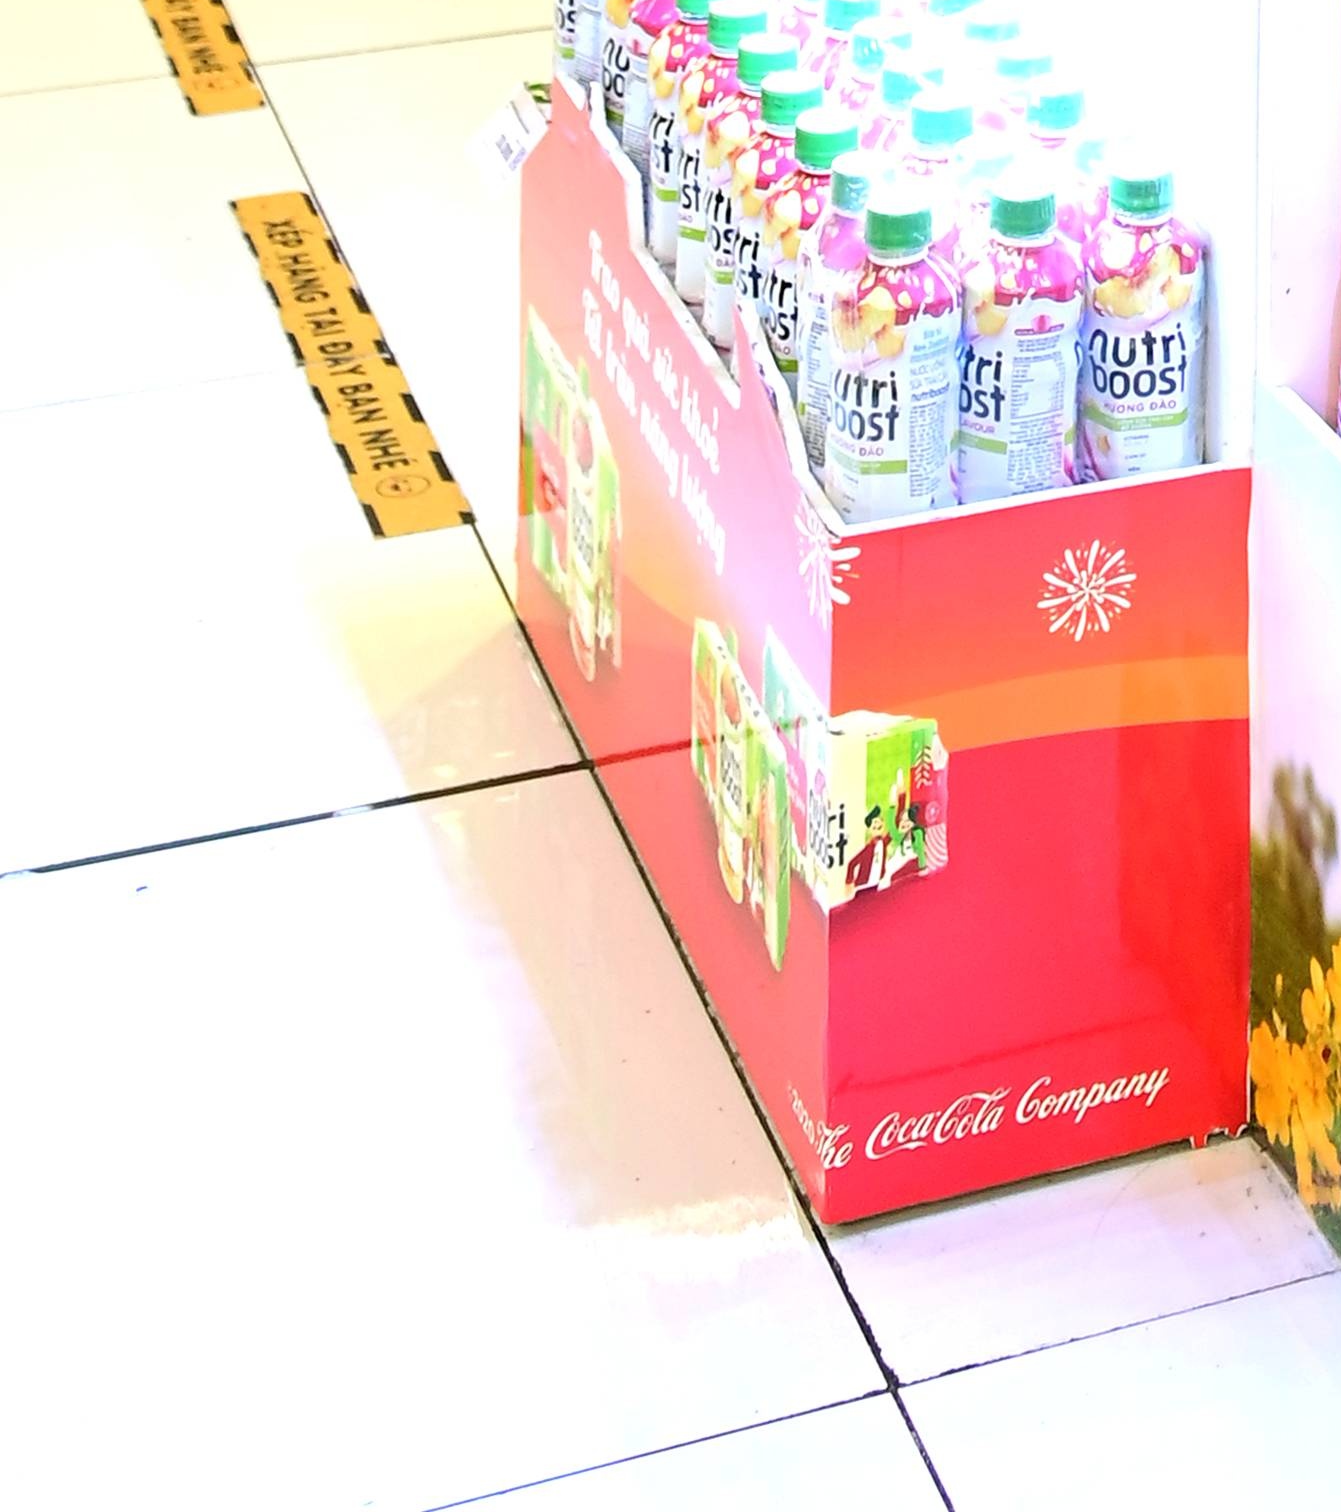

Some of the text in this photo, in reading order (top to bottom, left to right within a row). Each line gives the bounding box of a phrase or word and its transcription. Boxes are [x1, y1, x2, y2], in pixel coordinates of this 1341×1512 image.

[1088, 322, 1186, 368] nutri
[1088, 354, 1187, 399] boost
[864, 1090, 1006, 1164] Coca-Cola
[1014, 1066, 1172, 1127] Company
